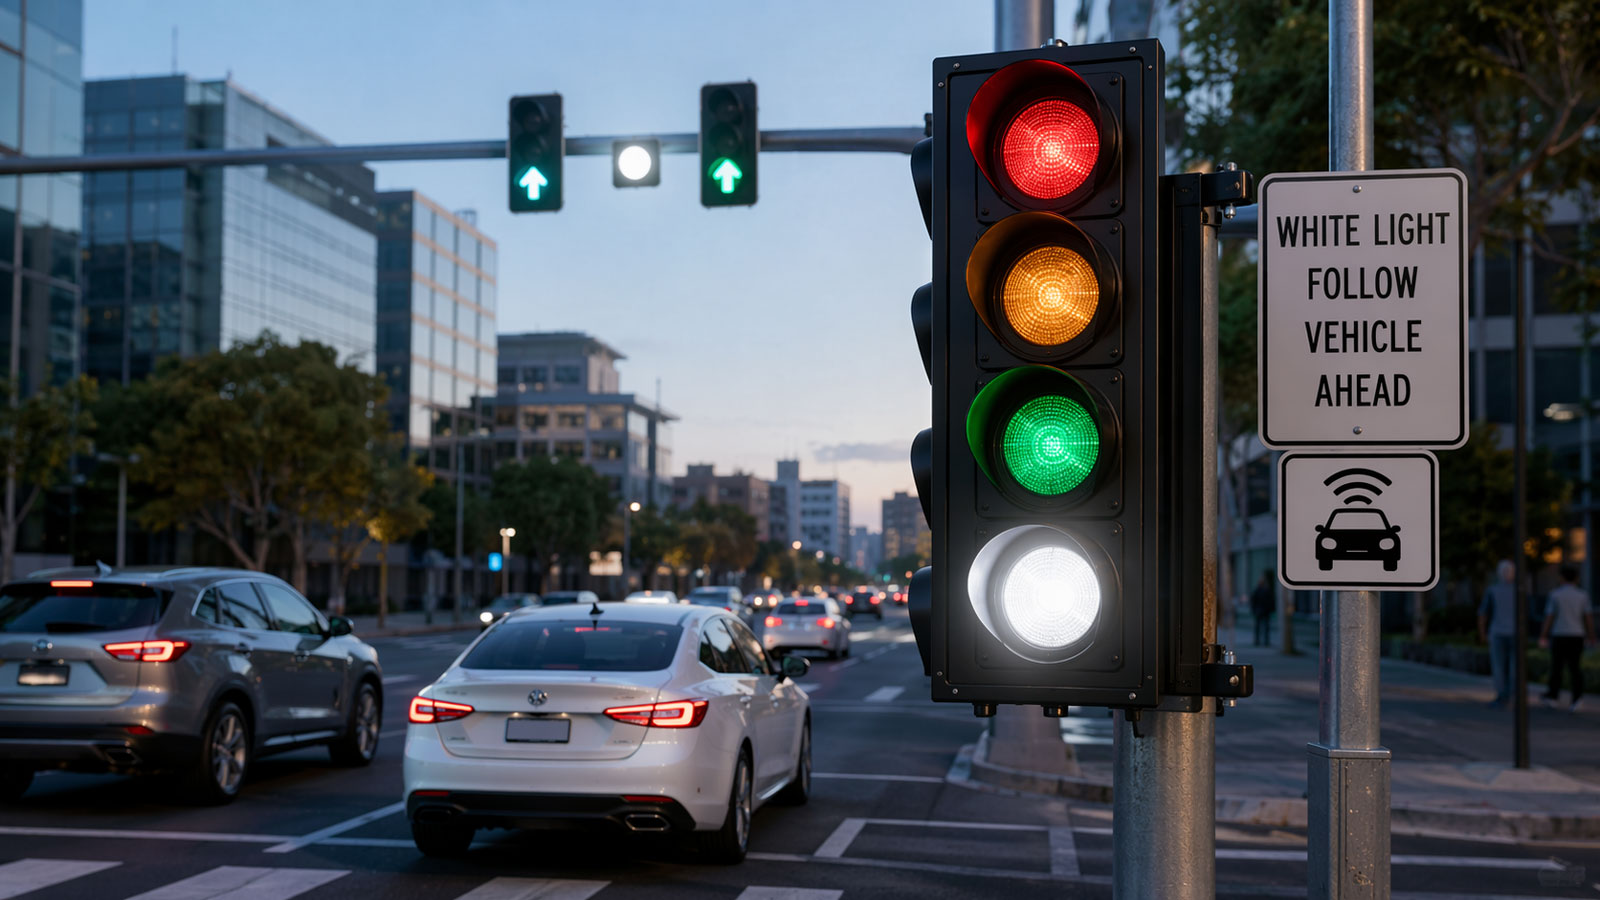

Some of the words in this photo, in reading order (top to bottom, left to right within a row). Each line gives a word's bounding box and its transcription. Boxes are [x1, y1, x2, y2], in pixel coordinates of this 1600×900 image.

[1276, 214, 1361, 248] WHITE
[1374, 212, 1451, 246] LIGHT
[1308, 266, 1418, 300] FOLLOW
[1304, 319, 1422, 354] VEHICLE
[1314, 373, 1411, 408] AHEAD
